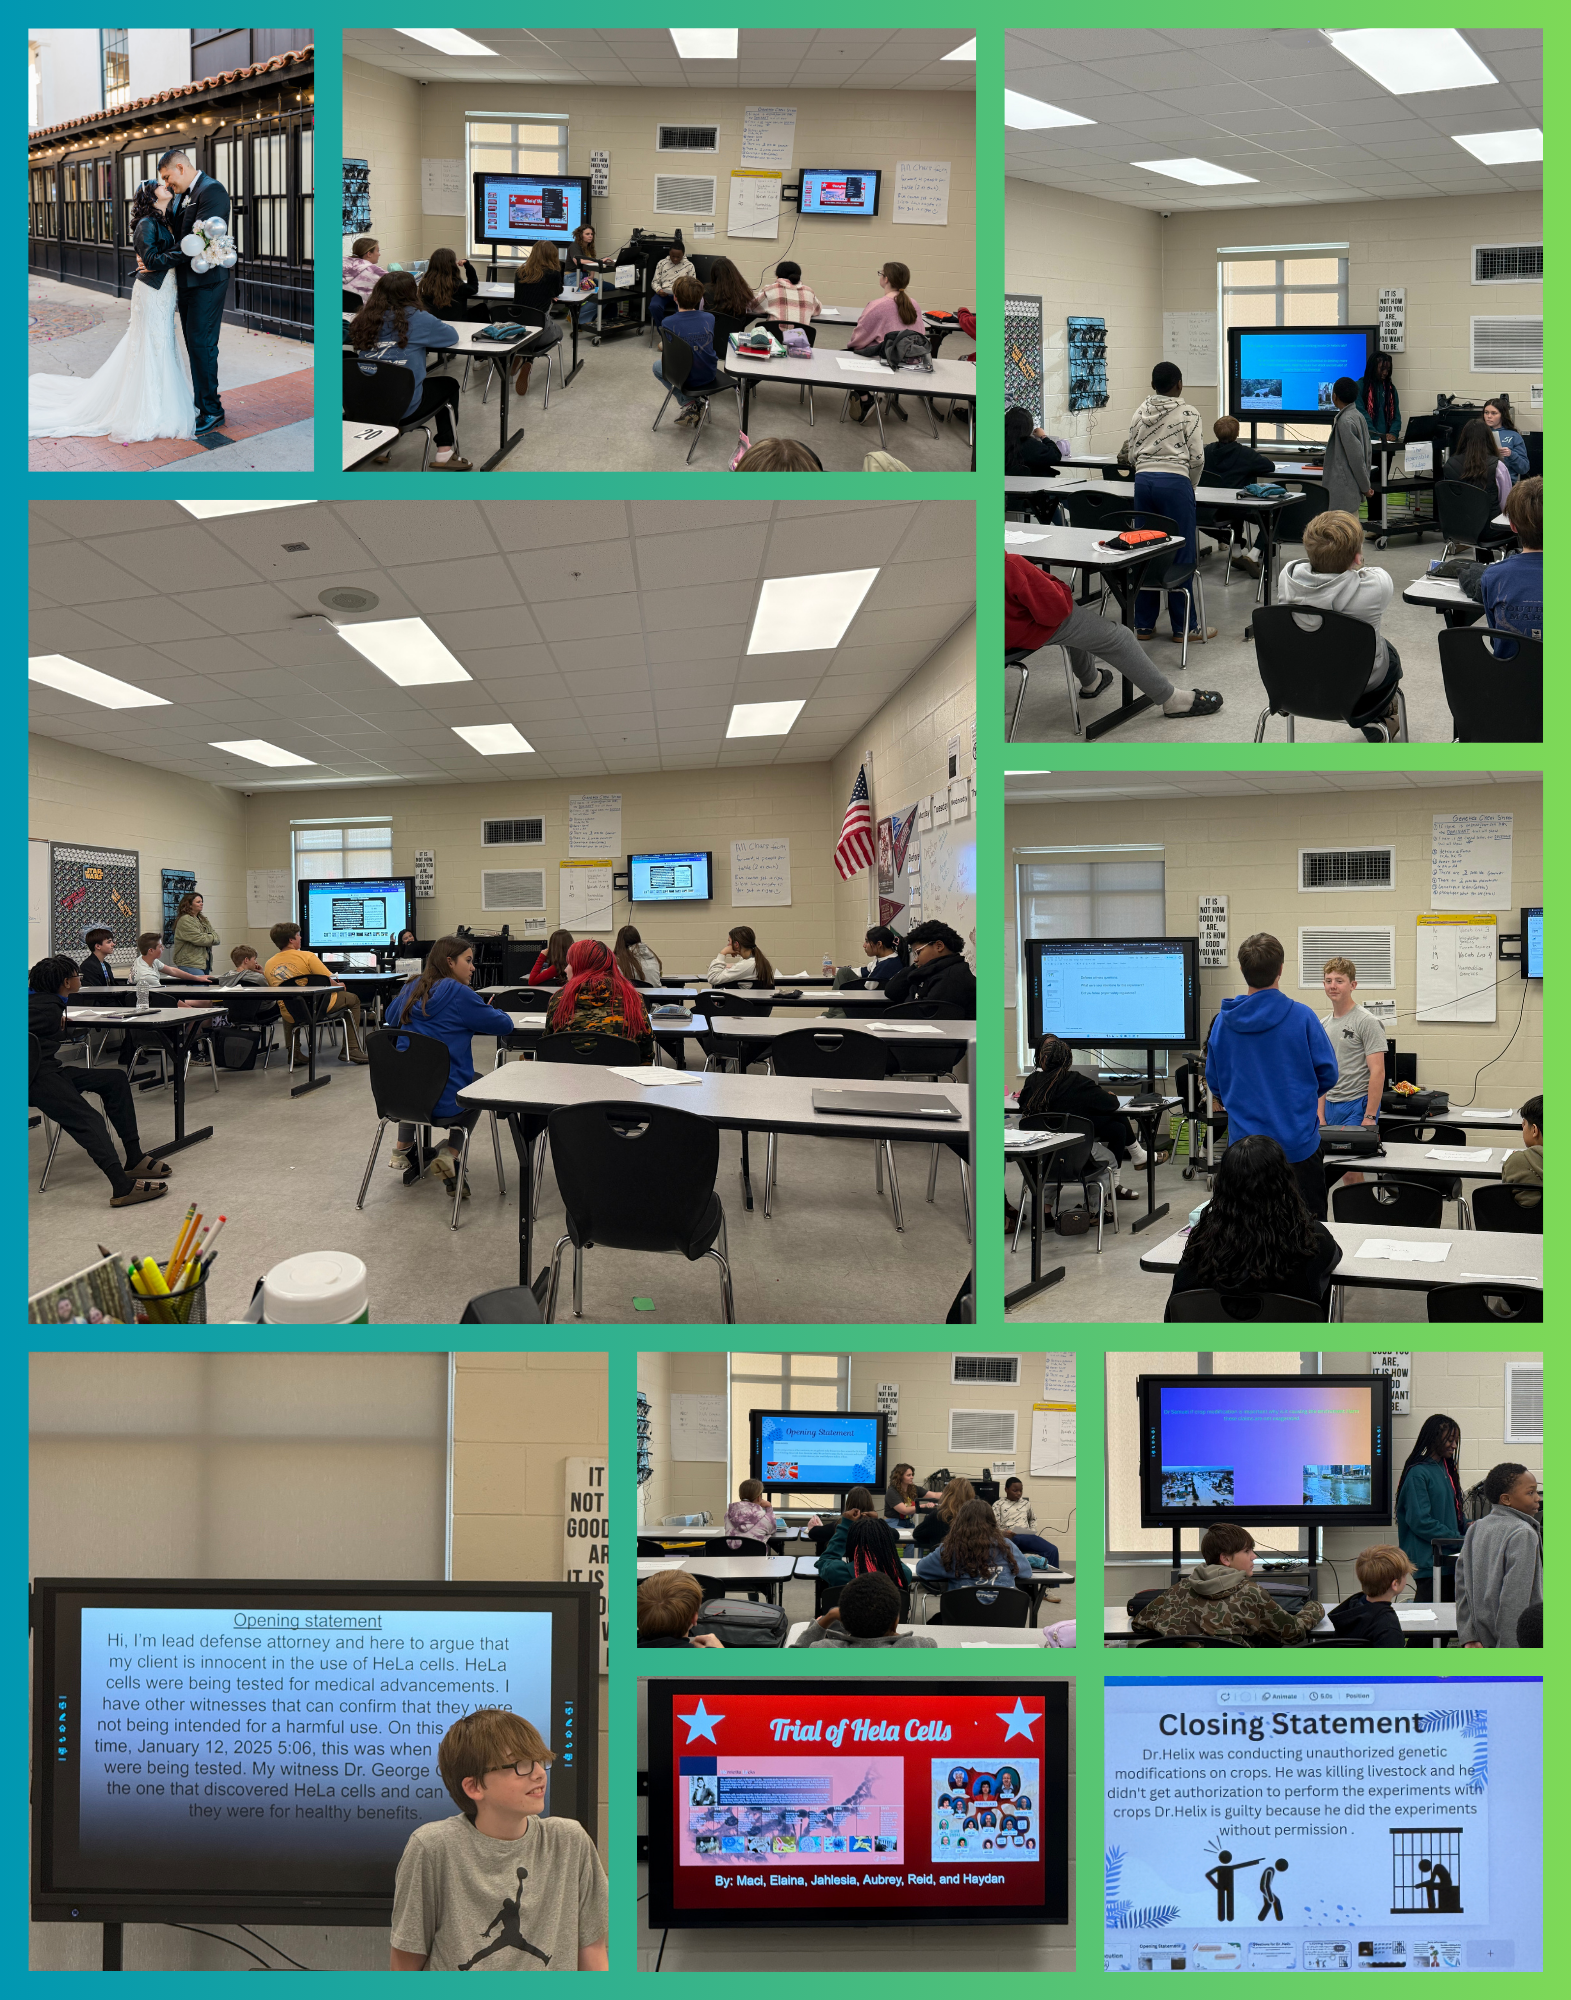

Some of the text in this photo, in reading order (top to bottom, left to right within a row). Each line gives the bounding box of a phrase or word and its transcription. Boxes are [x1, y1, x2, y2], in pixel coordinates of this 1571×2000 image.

[353, 428, 384, 441] 20
[933, 801, 949, 814] Tuesday
[950, 796, 968, 806] Wednesday
[84, 872, 104, 880] WARS
[1199, 906, 1225, 914] NOT HOW
[1199, 915, 1226, 923] GOOD YOU
[1205, 923, 1219, 931] ARE,
[1205, 940, 1220, 948] GOOD
[1210, 948, 1227, 956] WANT
[1203, 957, 1222, 965] TO BE.
[785, 1427, 854, 1438] Opening Statement
[588, 1466, 605, 1487] IT
[570, 1492, 605, 1513] NOT
[233, 1612, 382, 1628] Opening statement
[107, 1632, 509, 1654] Hi, I'm lead defense attorney and here to argue that
[109, 1653, 509, 1672] my client is innocent in the use of HeLa cells. HeLa
[105, 1675, 498, 1694] cells were being tested for medical advancements.
[1271, 1692, 1298, 1700] Animate
[1319, 1692, 1334, 1700] 5.0s
[1344, 1691, 1371, 1700] Position
[102, 1696, 471, 1717] have other witnesses that can confirm that they
[97, 1717, 445, 1736] not being intended for a harmful use. On this
[769, 1717, 952, 1748] Trial of Hela Cells
[1158, 1711, 1425, 1742] Closing Statement
[94, 1738, 432, 1757] time, January 12, 2025 5:06, this was when
[1142, 1744, 1447, 1762] Dr.Helix was conducting unauthorized genetic
[103, 1760, 430, 1781] were being tested. My witness Dr. George
[1115, 1763, 1476, 1781] modifications on crops. He was killing livestock and he
[106, 1780, 443, 1799] the one that discovered HeLa cells and can
[1107, 1781, 1484, 1802] didn't get authorization to perform the experiments with
[188, 1802, 424, 1824] they were for healthy benefits.
[1113, 1802, 1477, 1821] crops Dr.Helix is guilty because he did the experiments
[1219, 1822, 1347, 1838] without permission
[714, 1872, 1005, 1888] By: Maci, Elaina, Jahlesia, Aubrey, Reid, and Haydan
